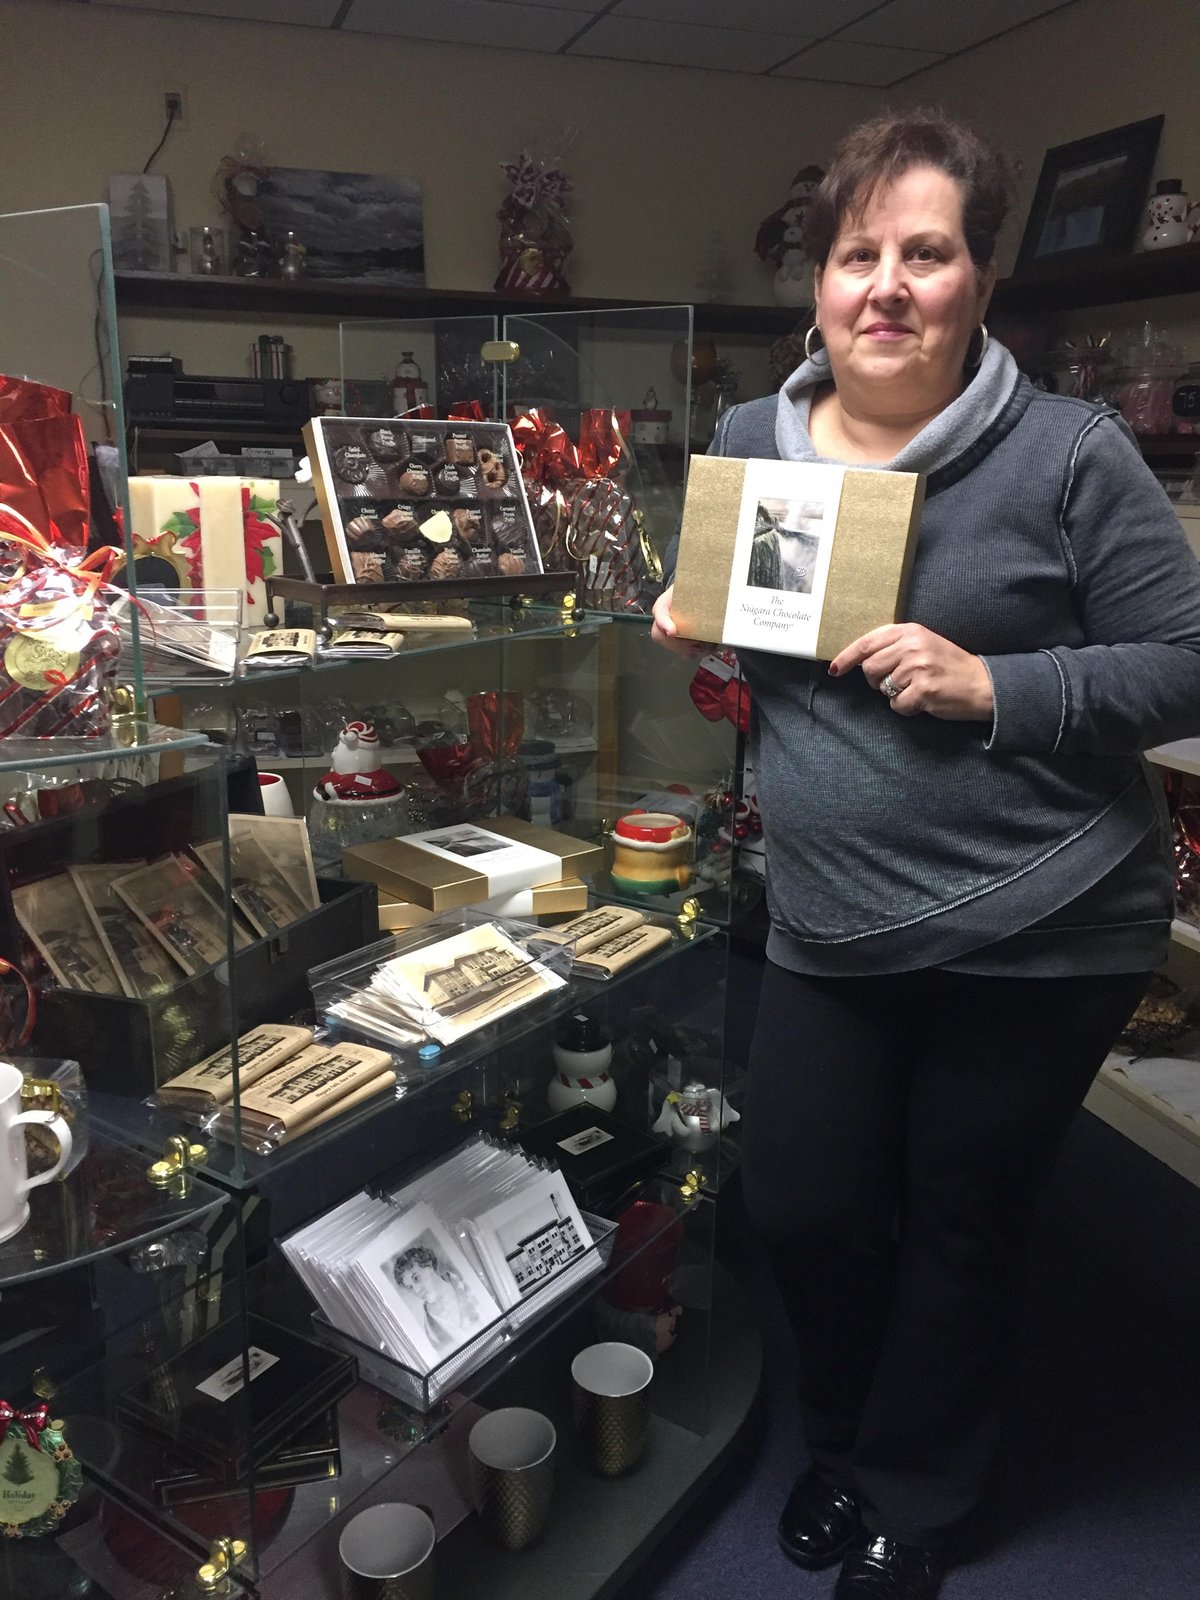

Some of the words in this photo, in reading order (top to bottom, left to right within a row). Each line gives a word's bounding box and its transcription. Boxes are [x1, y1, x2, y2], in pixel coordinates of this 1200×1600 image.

[770, 595, 785, 606] The
[740, 603, 771, 616] Niagara
[772, 608, 812, 621] Chocolate
[315, 1087, 332, 1098] Niagara
[3, 1489, 36, 1502] Holiday
